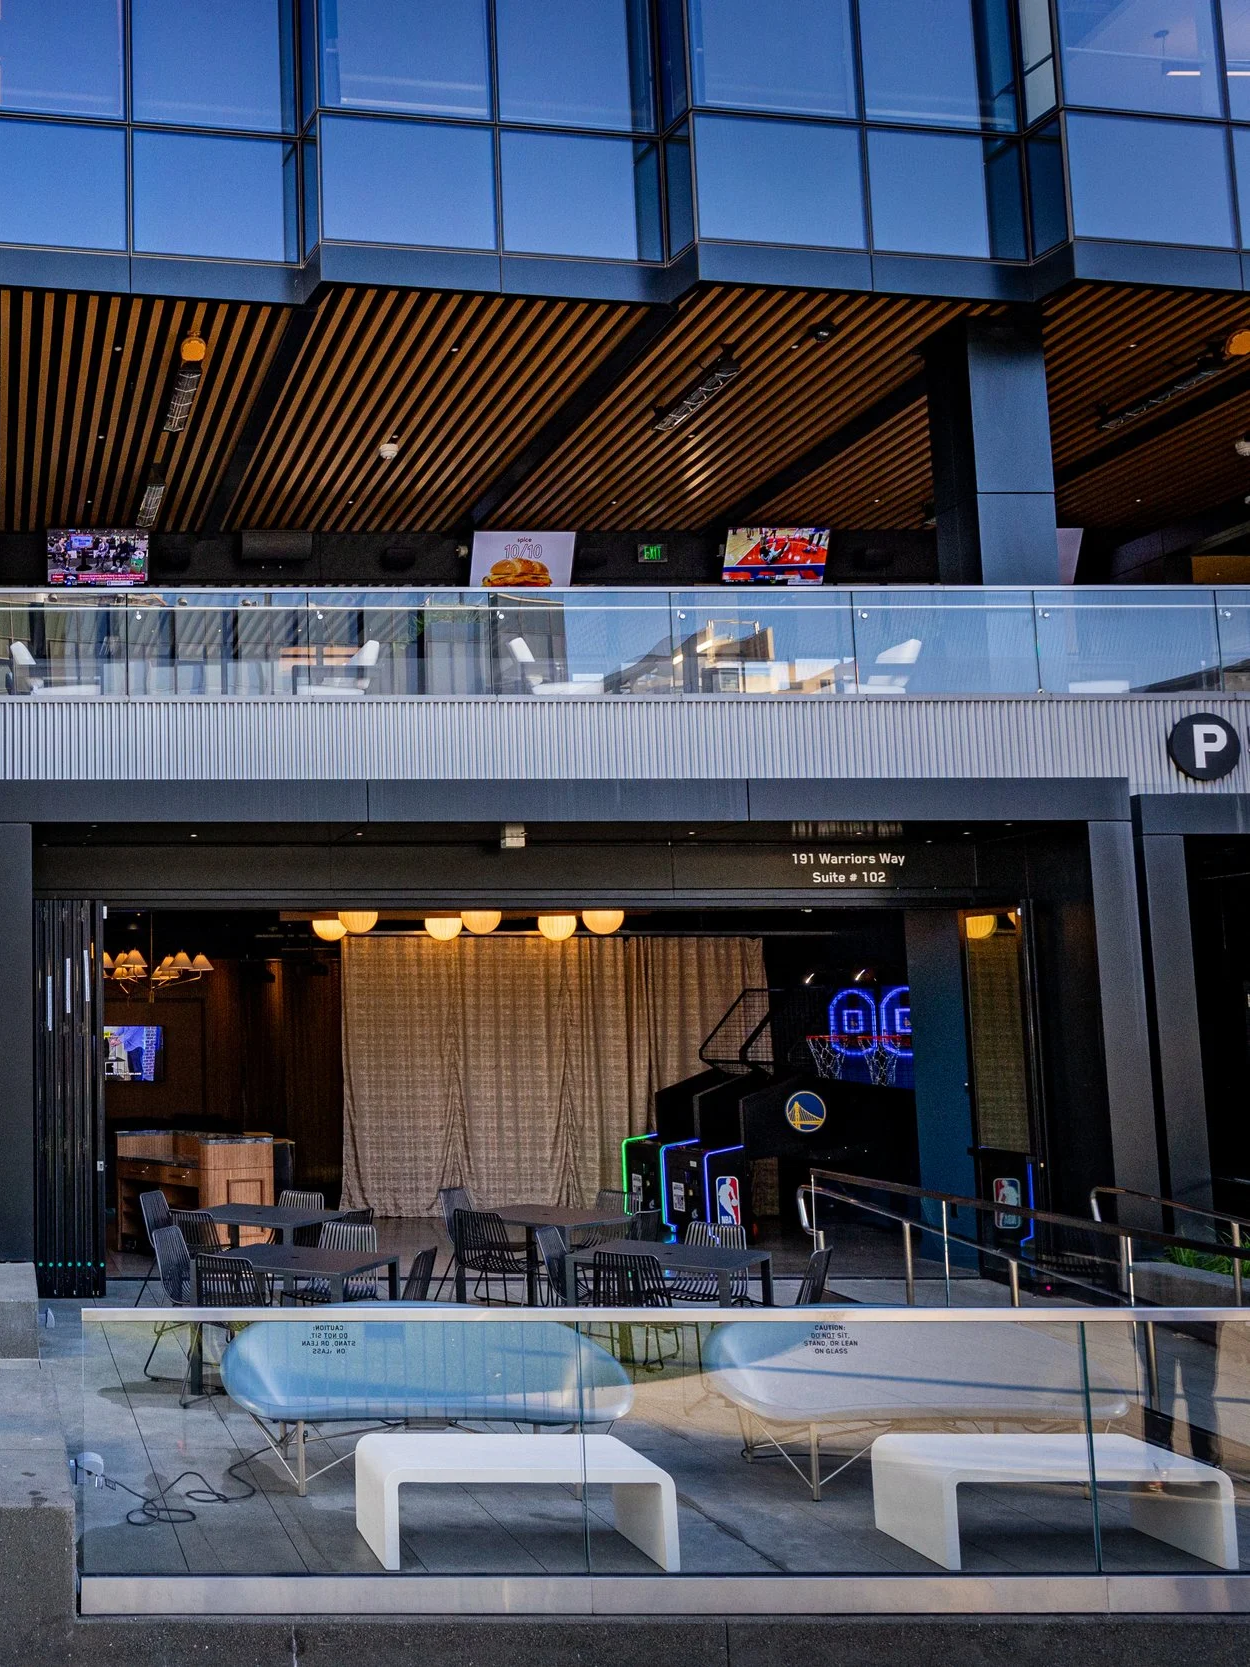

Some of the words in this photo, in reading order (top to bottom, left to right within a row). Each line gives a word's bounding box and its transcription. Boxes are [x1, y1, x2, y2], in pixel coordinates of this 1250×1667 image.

[517, 536, 532, 544] spice
[504, 543, 543, 559] 10/10
[643, 545, 662, 560] EXIT
[1192, 723, 1228, 769] P
[791, 853, 815, 865] 191
[818, 853, 876, 865] Warriors
[878, 853, 906, 867] Way
[812, 871, 846, 883] Suite
[849, 873, 858, 882] #
[861, 871, 886, 883] 102
[721, 1215, 732, 1224] NBA
